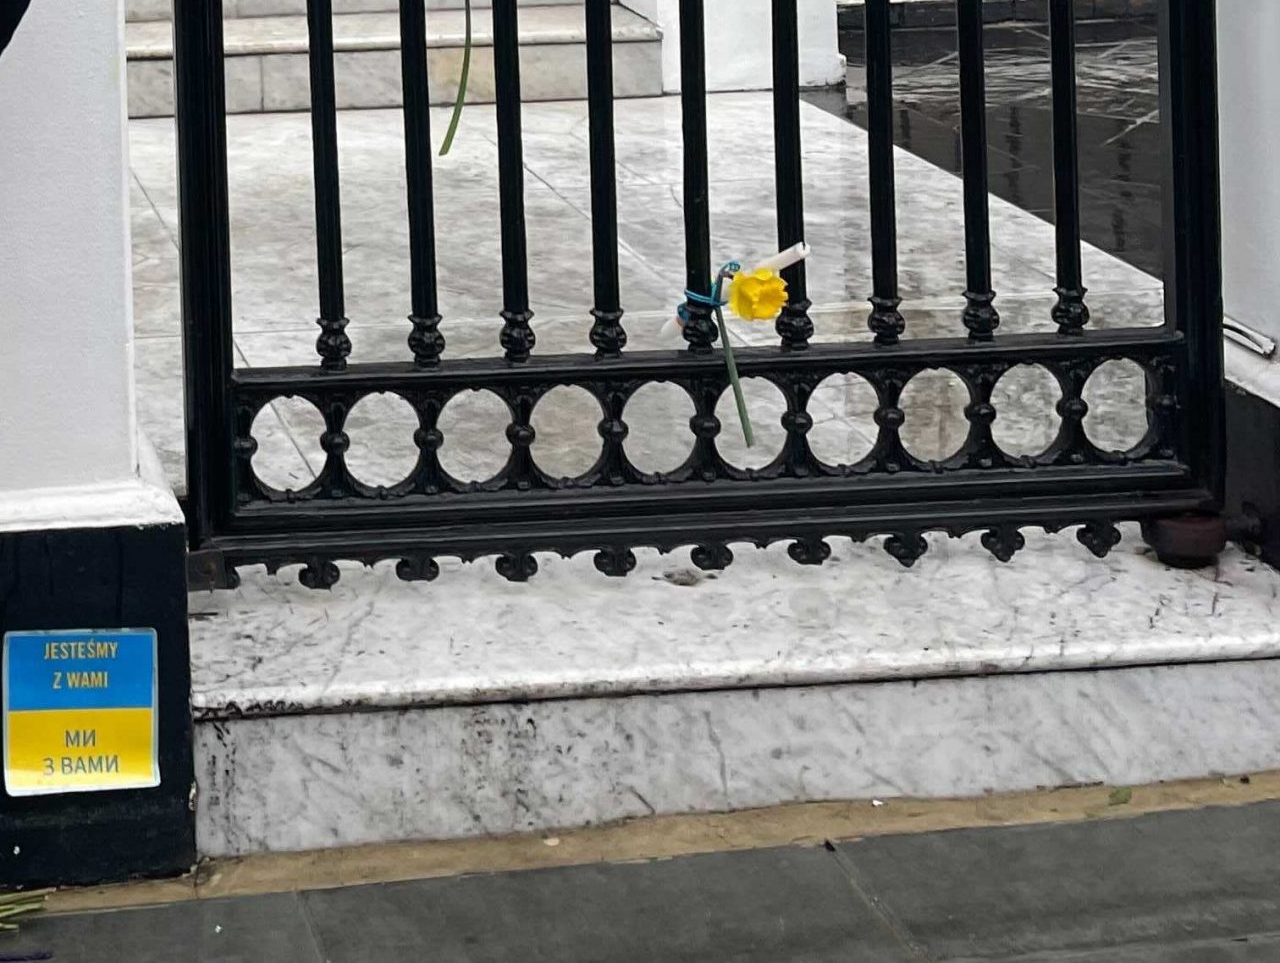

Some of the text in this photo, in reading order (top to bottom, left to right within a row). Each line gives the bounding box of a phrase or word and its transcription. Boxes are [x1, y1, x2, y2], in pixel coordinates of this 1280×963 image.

[44, 639, 118, 660] JESTEŚMY
[52, 671, 108, 689] Z WAMI
[65, 729, 96, 748] МИ
[43, 755, 119, 776] З ВАМИ
